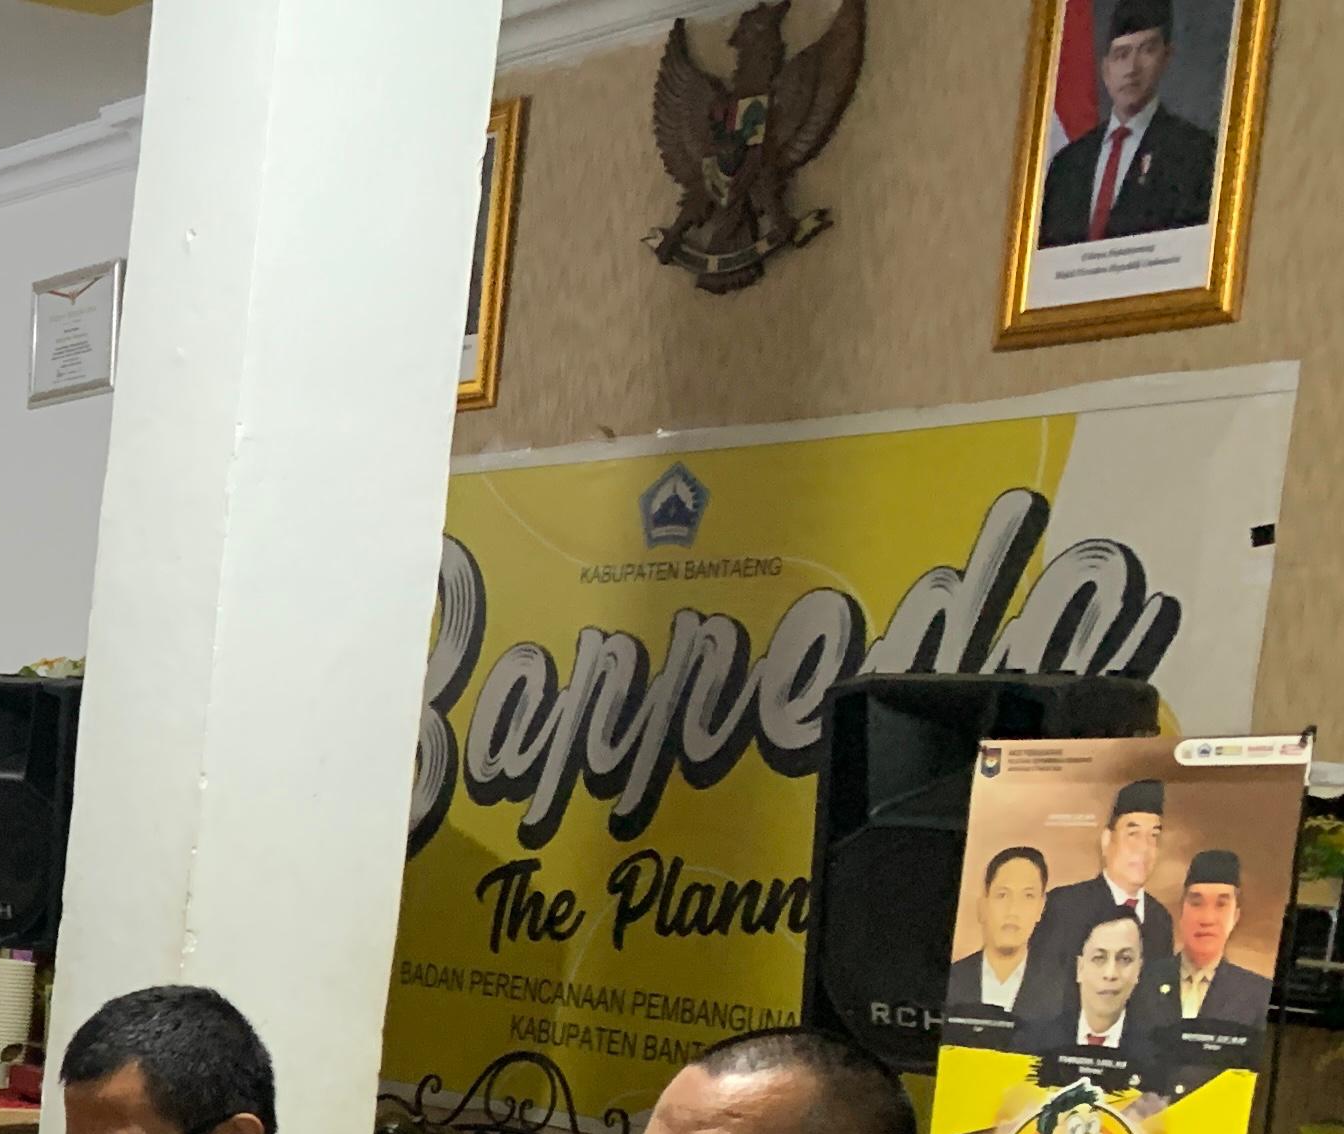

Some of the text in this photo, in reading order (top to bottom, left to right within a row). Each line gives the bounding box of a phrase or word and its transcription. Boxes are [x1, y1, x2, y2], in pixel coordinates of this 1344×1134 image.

[579, 557, 783, 584] KABUPATEN BANTAENG
[475, 858, 585, 953] The
[400, 961, 464, 992] BADAN
[468, 969, 627, 1015] PERENCANAAN
[511, 1014, 637, 1058] KABUPATEN
[871, 1002, 944, 1030] RCH
